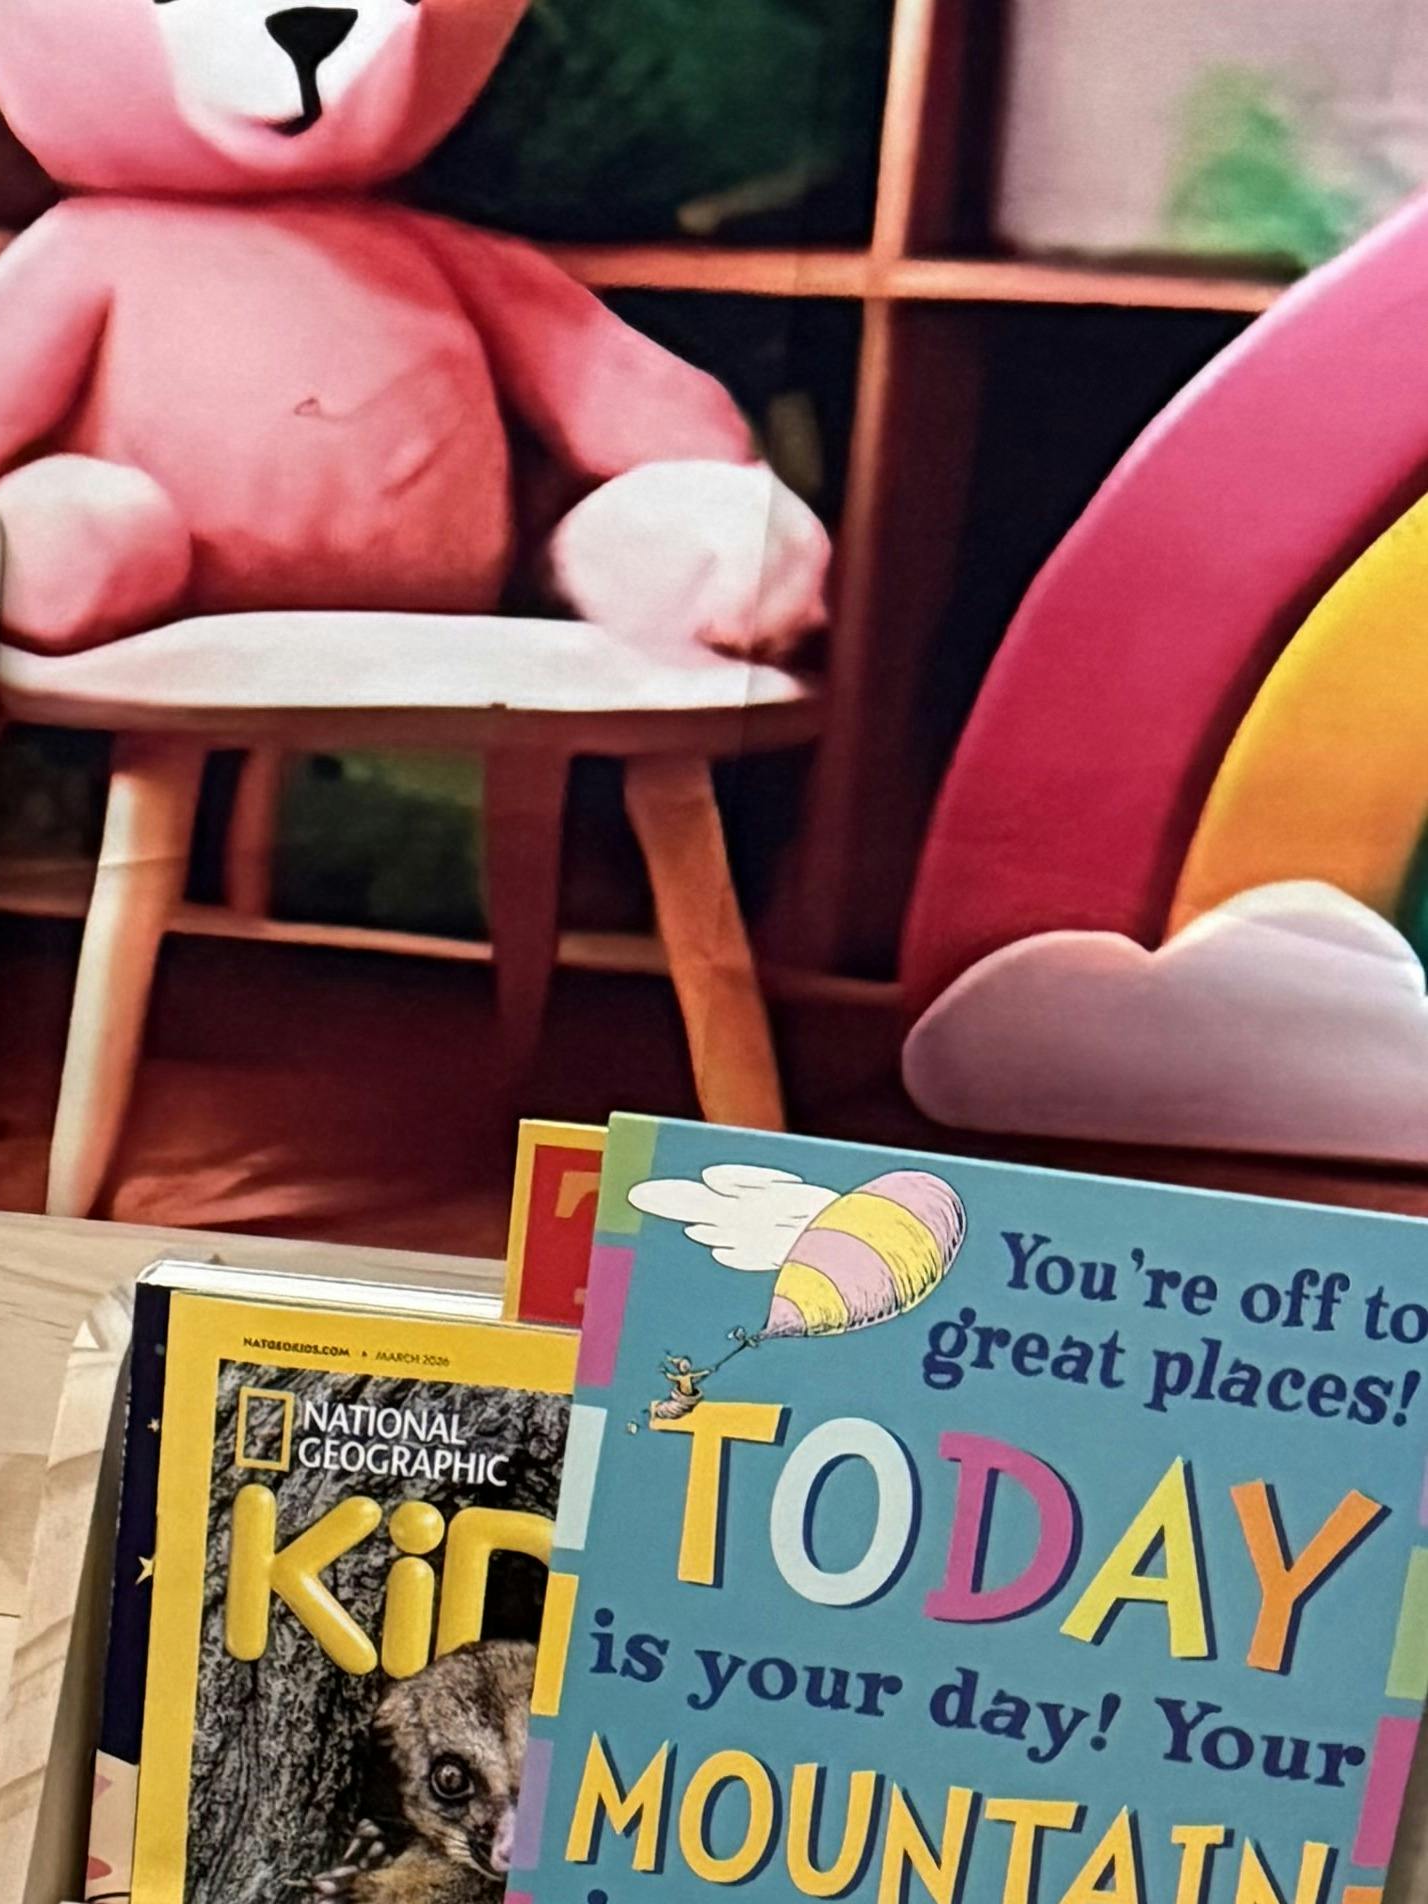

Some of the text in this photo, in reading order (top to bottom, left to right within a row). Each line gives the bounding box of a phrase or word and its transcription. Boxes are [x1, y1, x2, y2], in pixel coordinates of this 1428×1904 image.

[999, 1230, 1428, 1345] You're off to
[243, 1336, 350, 1358] NATGEOKIDS.COM
[375, 1350, 420, 1366] MARCH
[921, 1306, 1423, 1428] great places!
[298, 1436, 510, 1487] GEOGRAPHIC
[303, 1400, 467, 1446] NATIONAL
[648, 1400, 1392, 1677] TODAY
[587, 1606, 1369, 1789] is your day! Your
